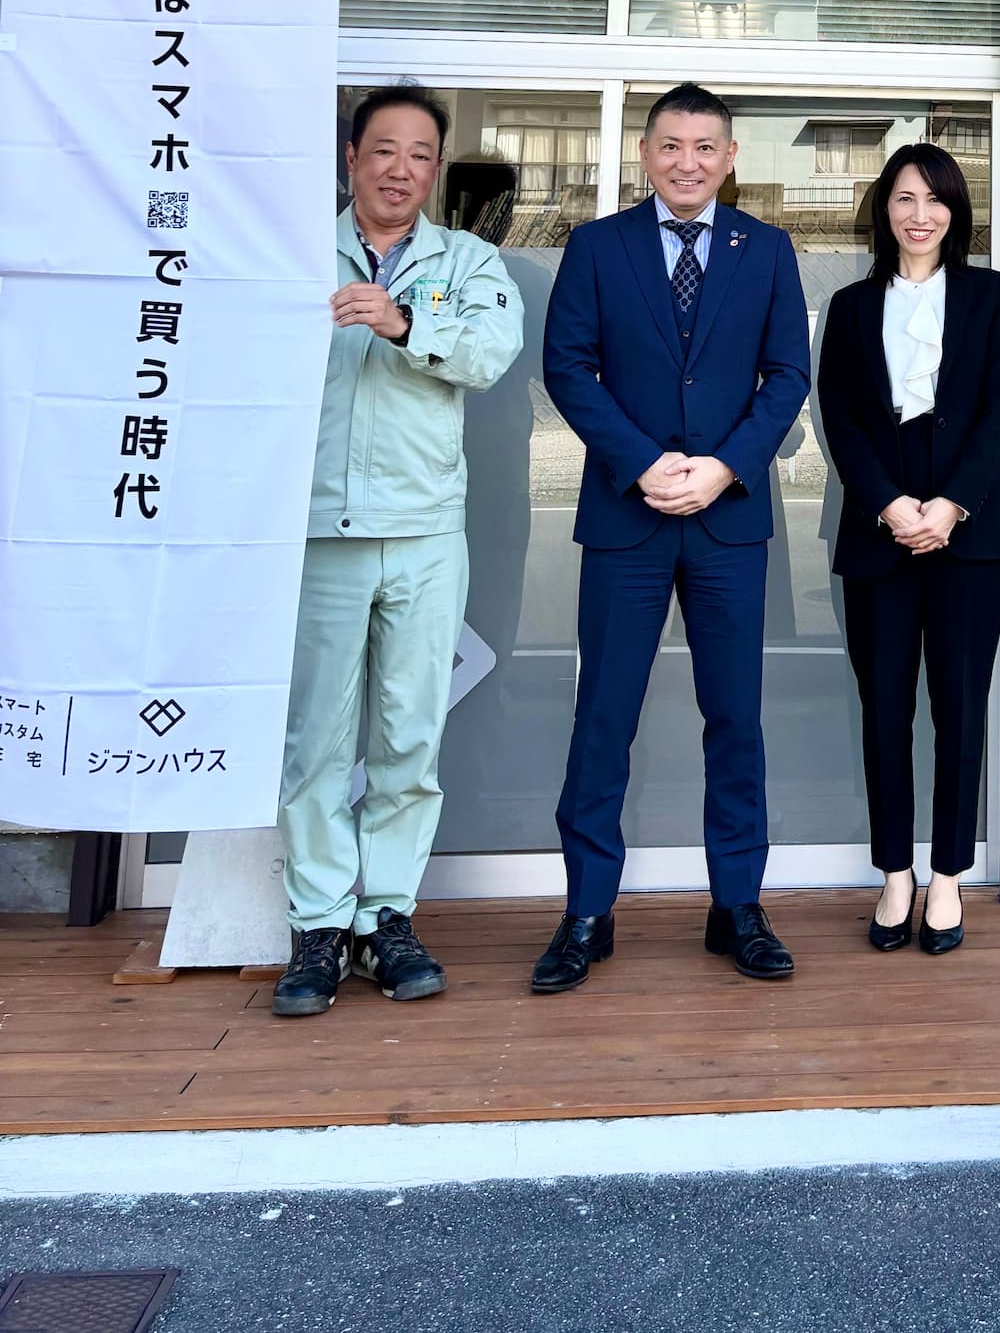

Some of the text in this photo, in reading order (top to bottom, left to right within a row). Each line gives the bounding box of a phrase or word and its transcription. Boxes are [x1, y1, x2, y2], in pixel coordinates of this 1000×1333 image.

[113, 248, 188, 521] で買う時代
[0, 722, 44, 741] スタム
[87, 748, 227, 775] ジブンハウス
